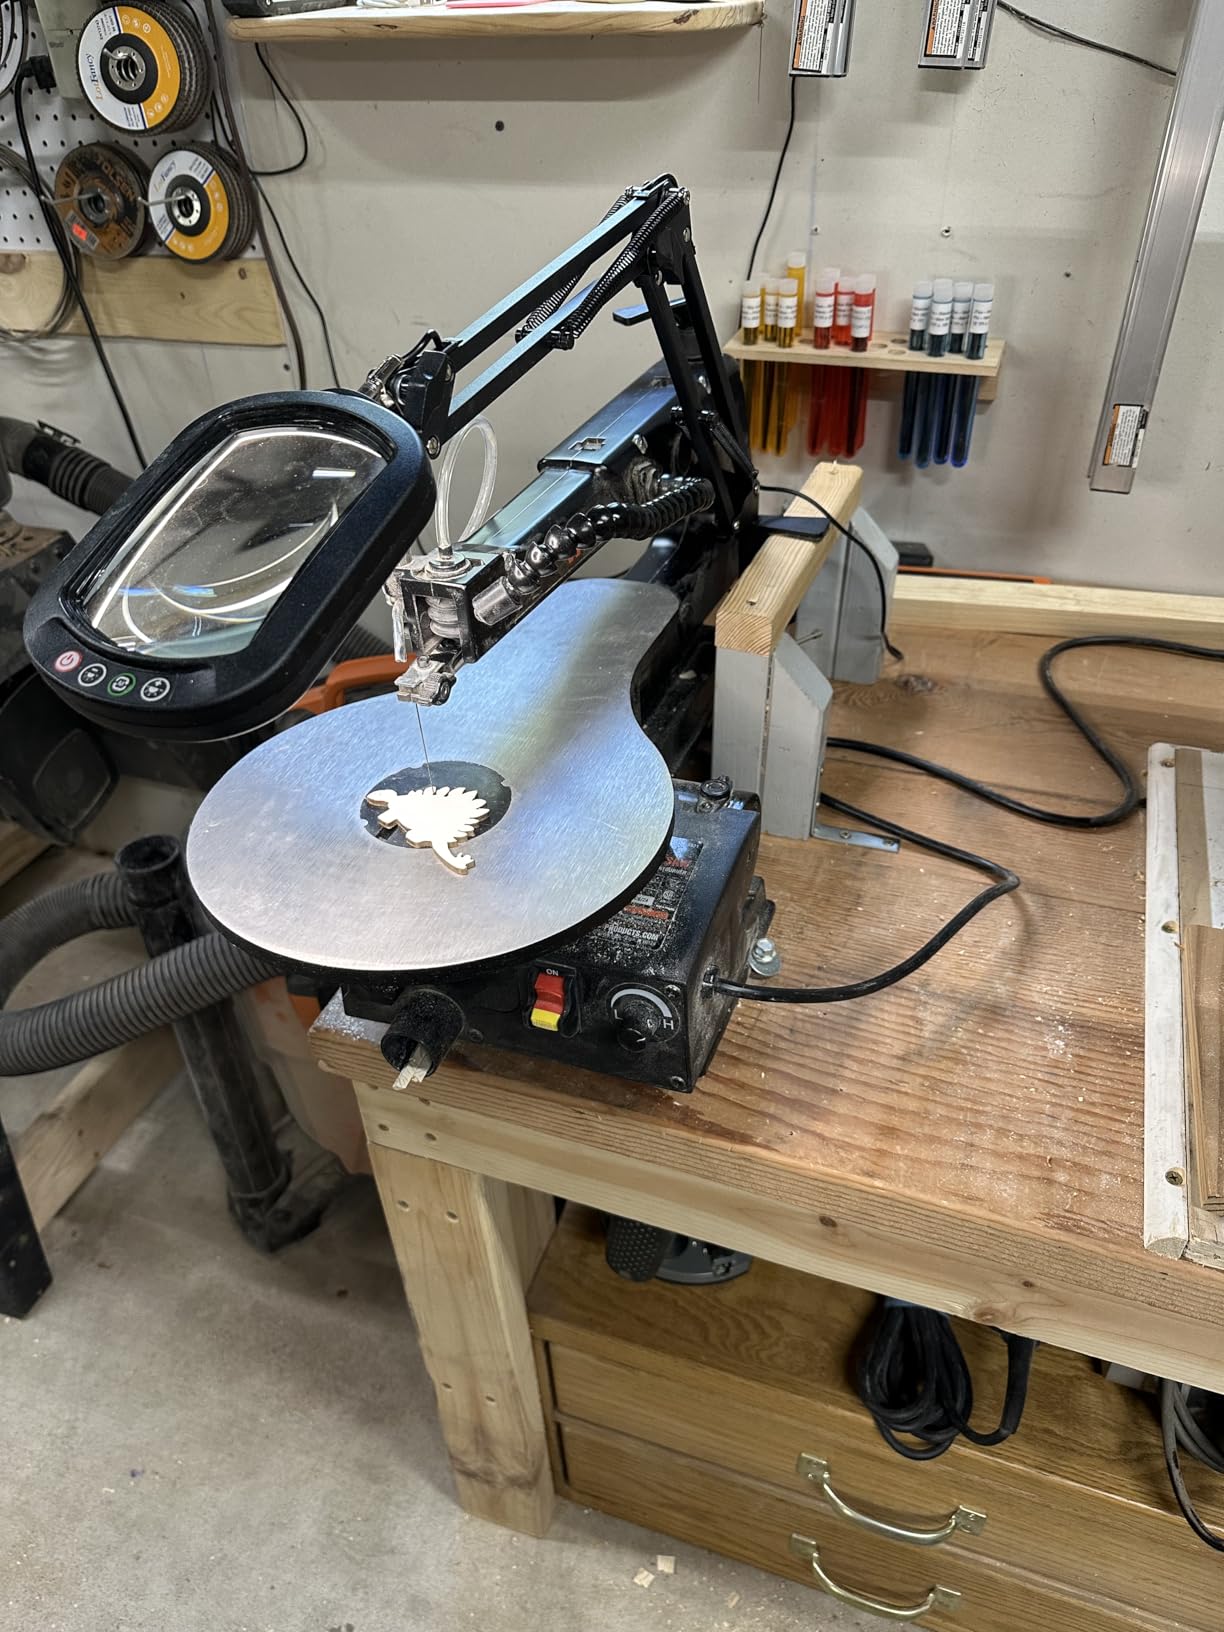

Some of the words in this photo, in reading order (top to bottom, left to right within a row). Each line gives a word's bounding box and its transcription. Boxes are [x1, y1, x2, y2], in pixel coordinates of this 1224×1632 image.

[545, 968, 559, 976] ON
[613, 1009, 623, 1020] L
[662, 1018, 675, 1030] H
